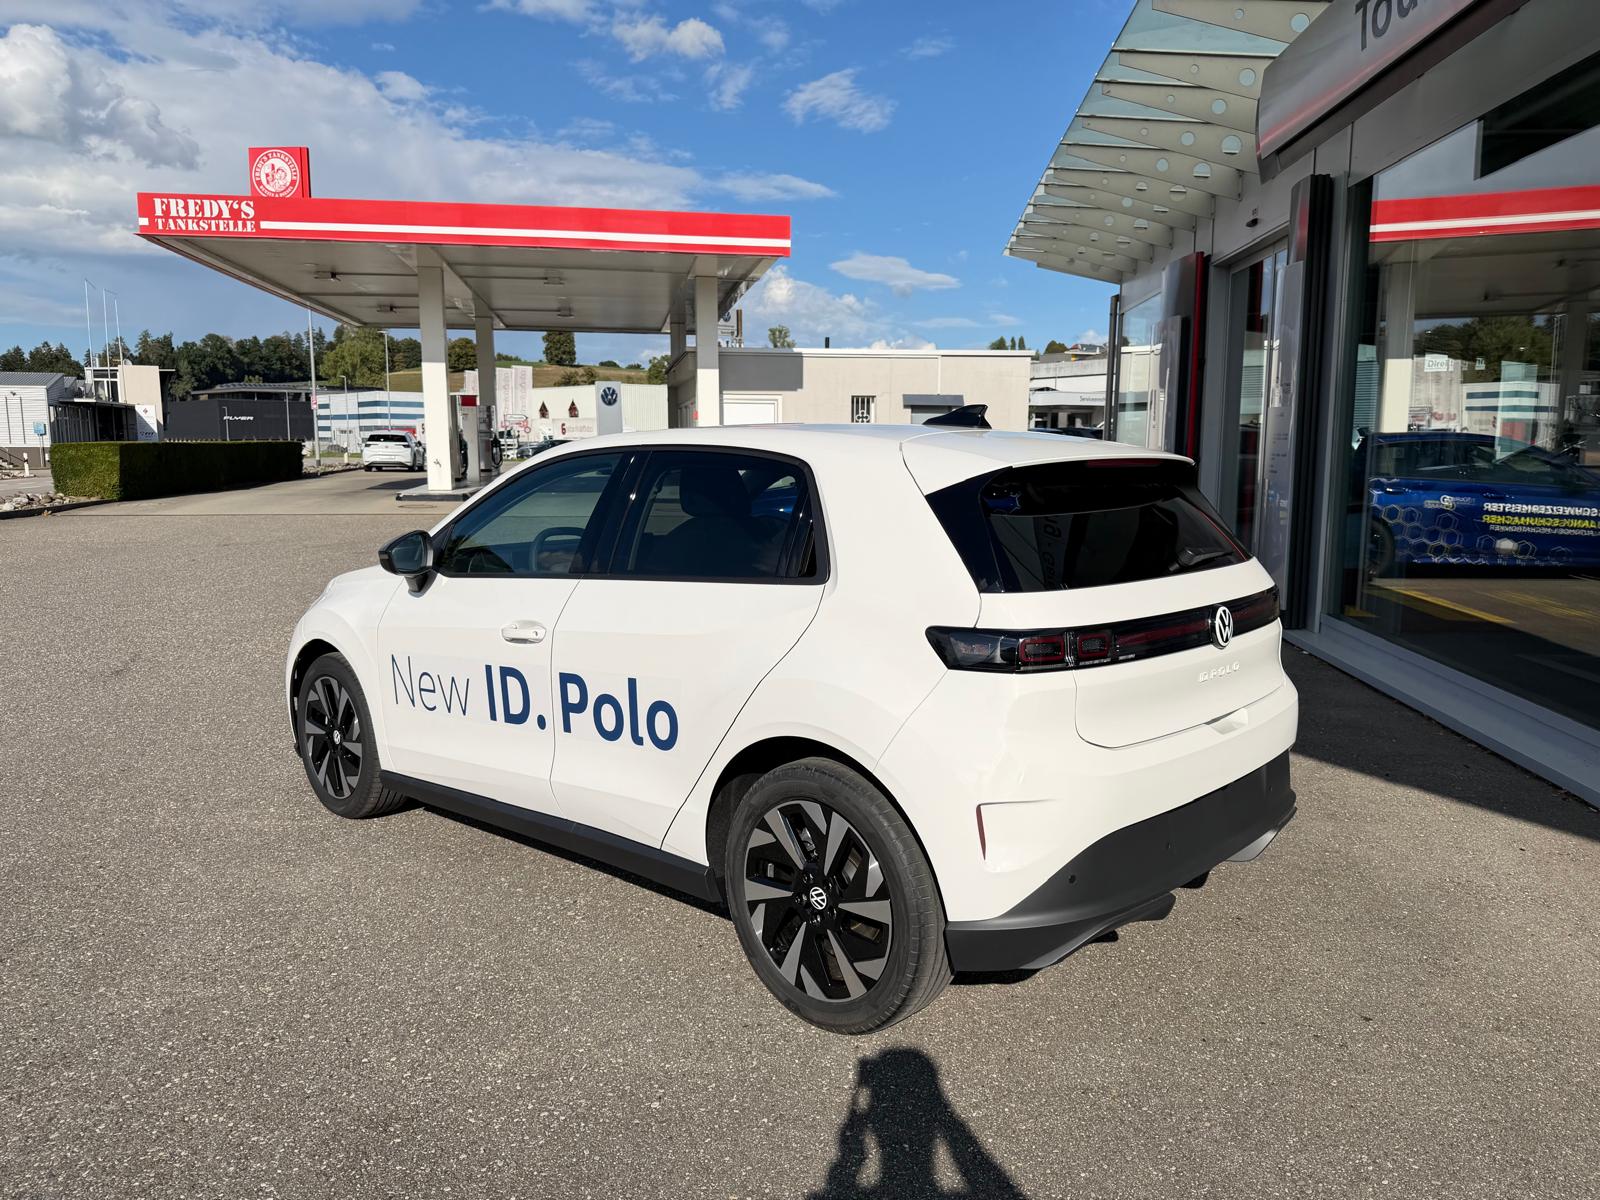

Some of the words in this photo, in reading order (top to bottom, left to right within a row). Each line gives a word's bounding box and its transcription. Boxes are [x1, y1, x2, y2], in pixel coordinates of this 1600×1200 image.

[153, 198, 255, 219] FREDY'S
[155, 219, 256, 232] TANKSTELLE
[391, 653, 470, 716] New
[485, 664, 547, 731] ID.
[558, 671, 679, 751] Polo
